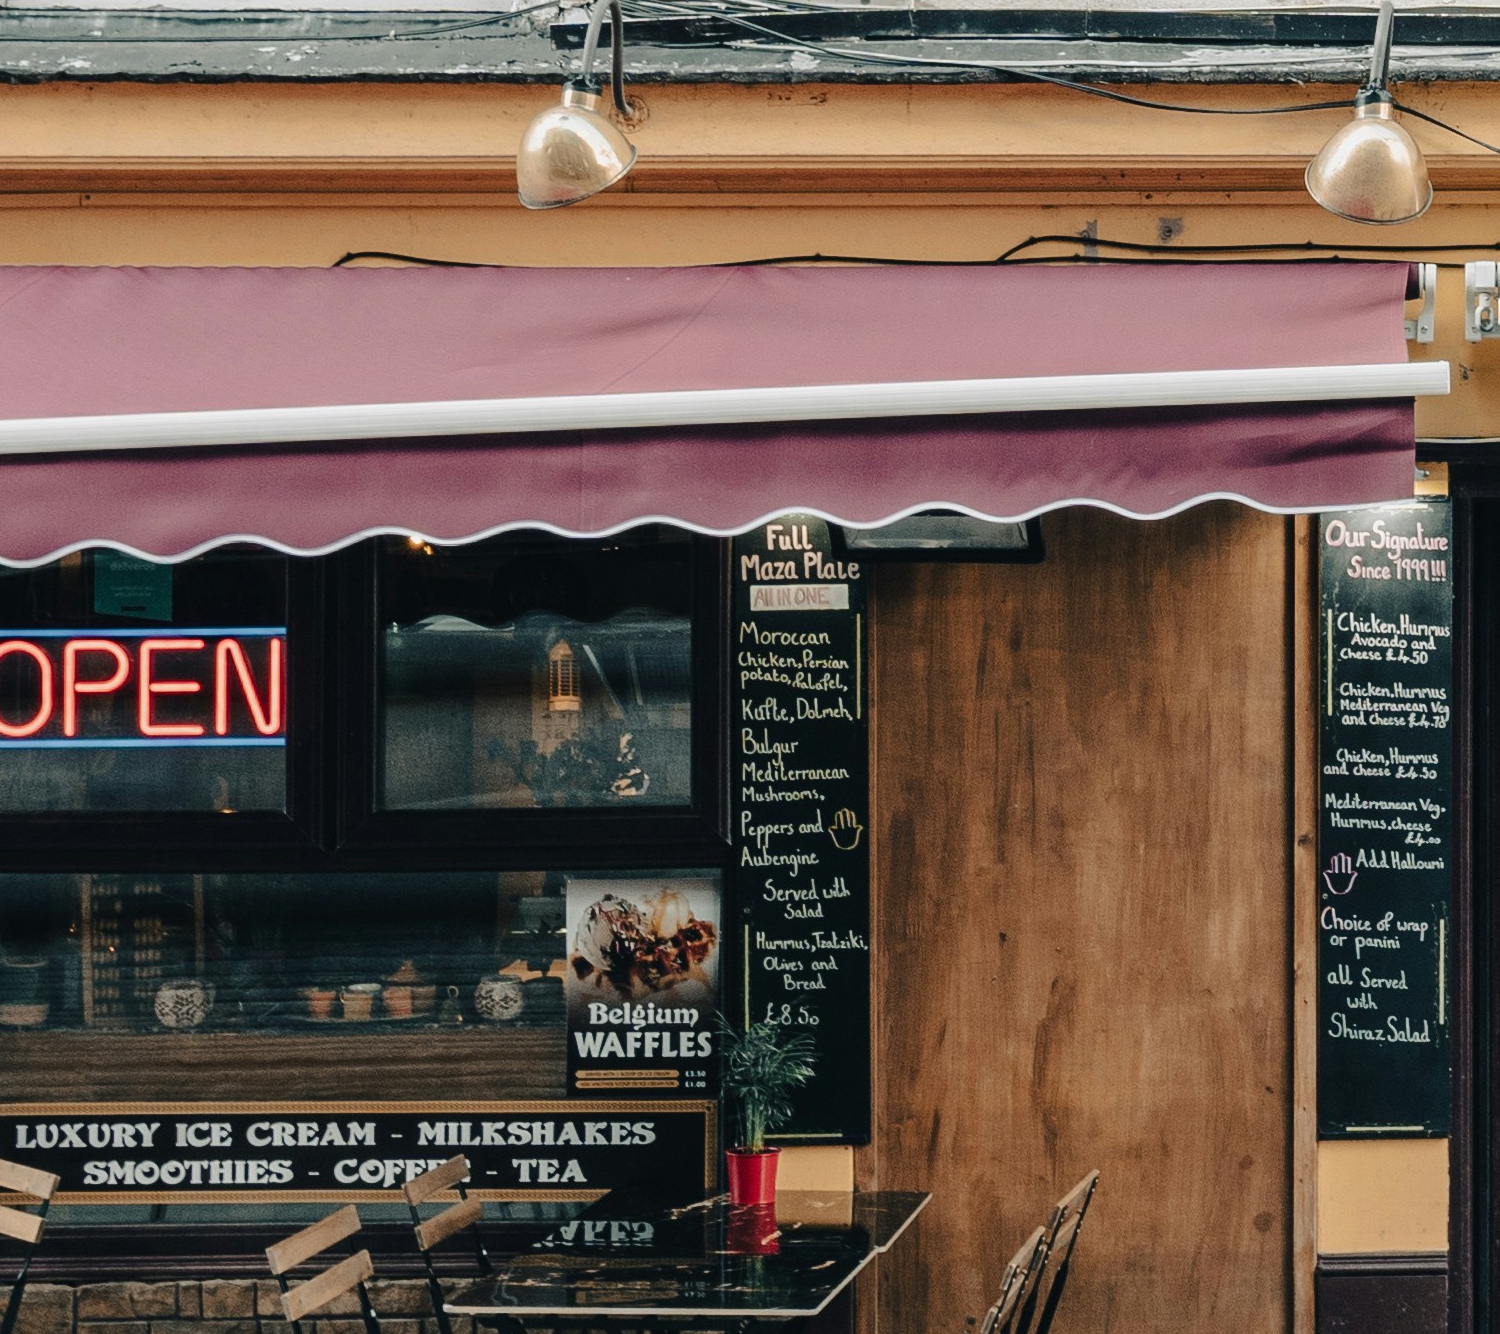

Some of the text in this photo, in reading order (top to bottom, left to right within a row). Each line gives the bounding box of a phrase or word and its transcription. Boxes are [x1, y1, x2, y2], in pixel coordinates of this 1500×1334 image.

[766, 525, 813, 550] Full
[1325, 519, 1448, 559] Our Signature
[741, 552, 860, 581] Maza Plate
[1347, 555, 1391, 579] Since
[794, 587, 830, 606] ONE
[740, 621, 831, 645] Moroccan
[1351, 633, 1437, 650] Avocado and
[802, 649, 849, 669] Persian
[1340, 648, 1382, 661] Cheese
[1340, 698, 1451, 722] Mediterranean Veg
[1342, 711, 1367, 726] and
[742, 728, 798, 766] Bulgur
[1389, 747, 1439, 764] Hummus
[742, 762, 850, 782] Mediterranean
[1323, 762, 1349, 775] and
[1325, 793, 1417, 811] Mediterranean
[741, 808, 824, 849] Peppers and
[1356, 848, 1444, 869] Add Halloumi
[763, 877, 850, 901] Served with
[784, 903, 824, 919] Salad
[1321, 906, 1428, 942] Choice of wrap
[1330, 935, 1400, 960] or panini
[763, 955, 838, 971] Olives and
[783, 973, 826, 990] Bread
[1327, 963, 1408, 989] all Served
[1346, 993, 1378, 1009] with
[588, 1002, 699, 1031] Belgium
[764, 1002, 820, 1025] £8.50
[1328, 1012, 1430, 1042] Shiraz Salad
[574, 1031, 712, 1058] WAFFLES
[15, 1121, 657, 1149] LUXURY ICE CREAM MILKSHAKES
[83, 1159, 294, 1186] SMOOTHIES
[511, 1158, 588, 1184] TEA
